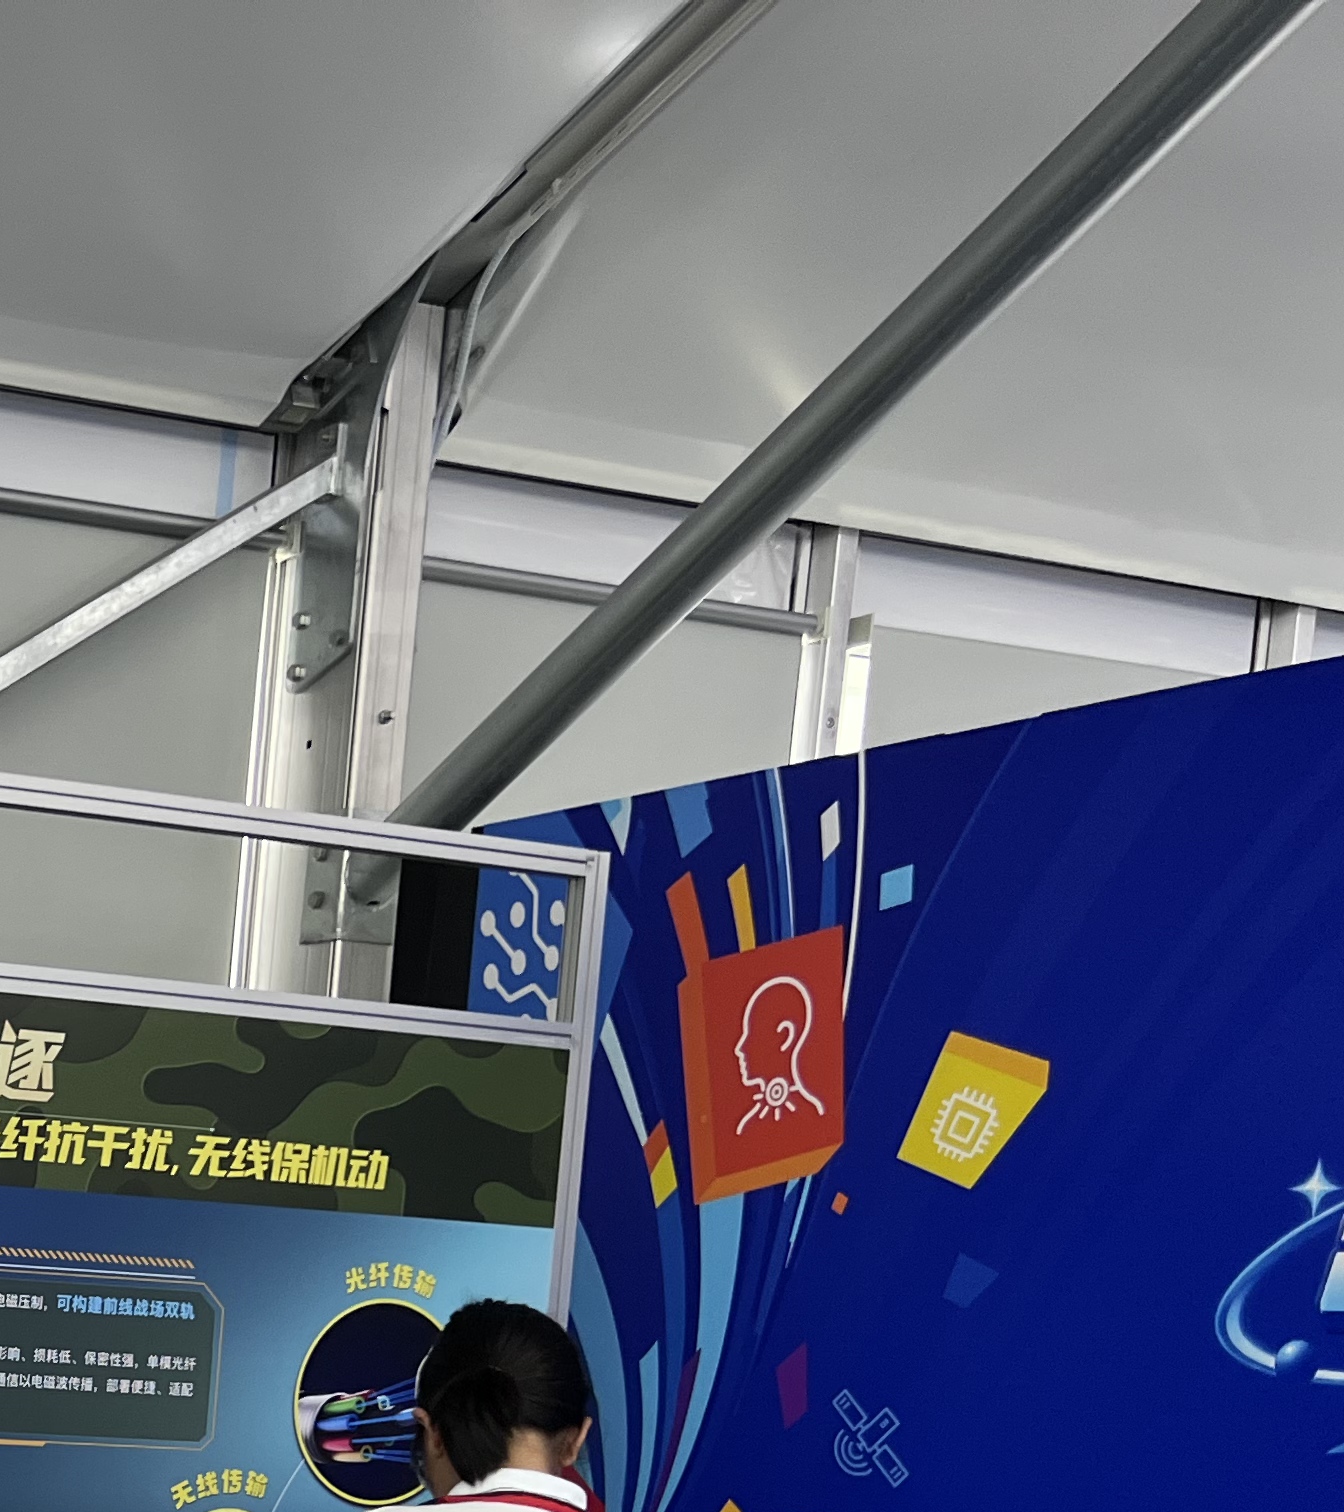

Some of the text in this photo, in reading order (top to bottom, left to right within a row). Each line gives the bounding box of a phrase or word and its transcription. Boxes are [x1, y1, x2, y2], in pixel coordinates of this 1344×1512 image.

[345, 1262, 428, 1299] 光纤传输
[170, 1468, 269, 1510] 无线传输
